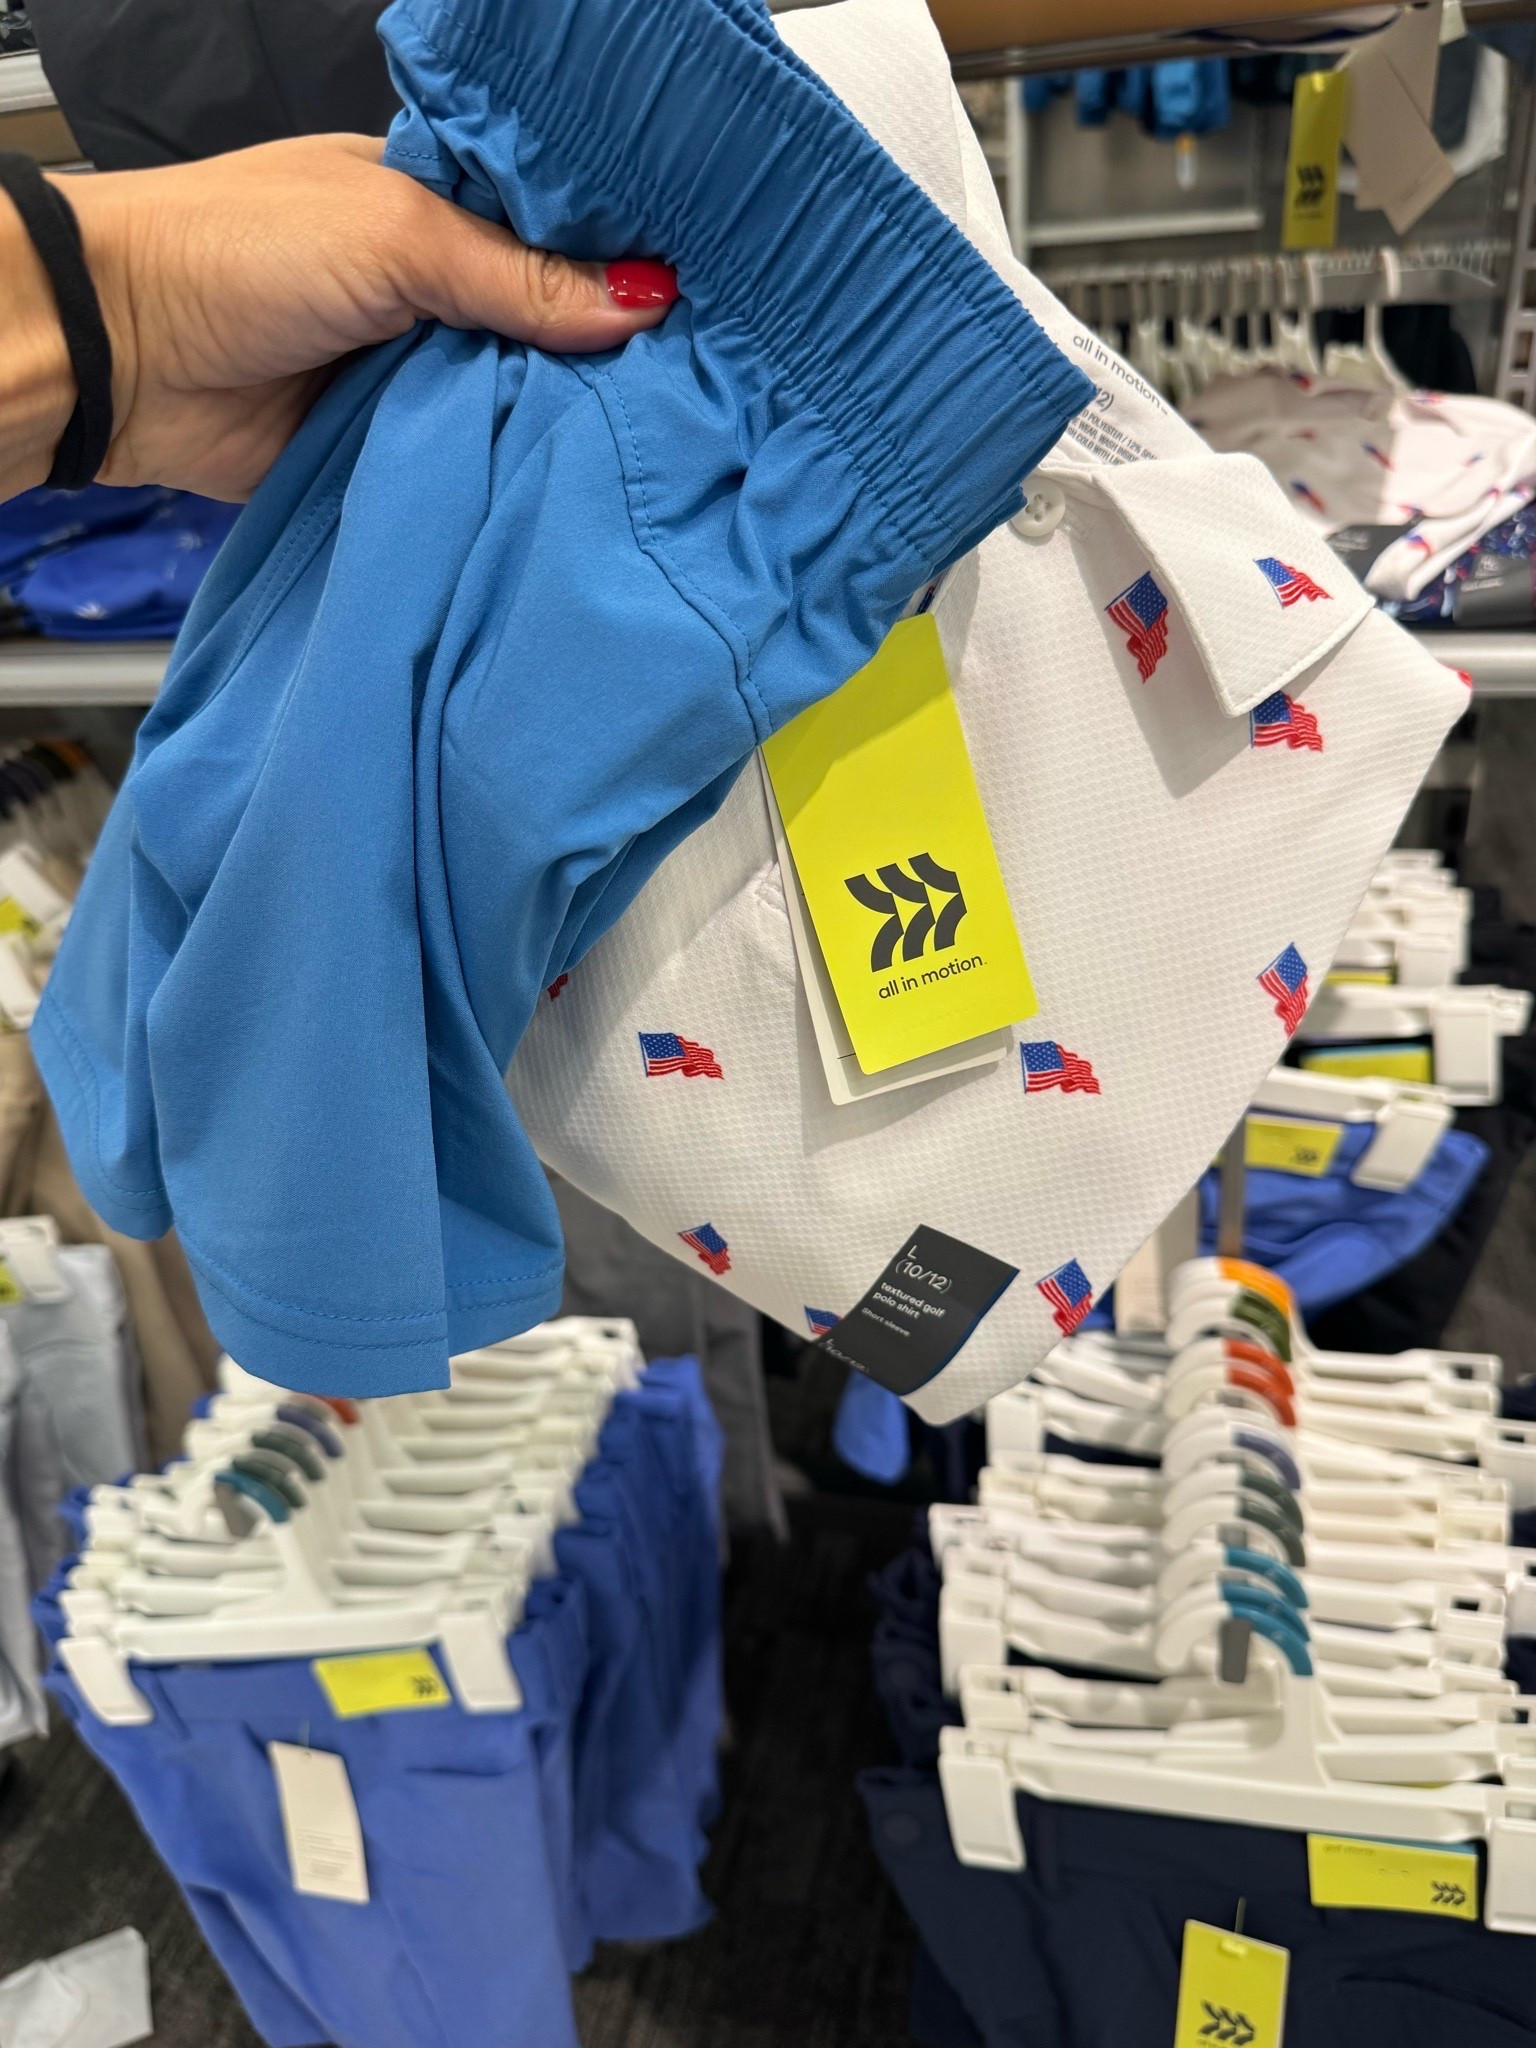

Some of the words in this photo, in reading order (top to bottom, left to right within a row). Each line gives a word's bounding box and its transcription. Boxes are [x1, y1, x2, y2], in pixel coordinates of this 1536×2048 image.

[1073, 335, 1093, 353] all
[1094, 345, 1109, 366] in
[1111, 360, 1161, 408] motion
[1076, 430, 1095, 450] COLD
[1088, 412, 1123, 441] POLYESTER
[1098, 433, 1119, 452] WASH
[878, 979, 899, 999] all
[900, 976, 919, 992] in
[921, 955, 983, 985] motion
[907, 1244, 918, 1260] L
[895, 1258, 953, 1294] (10/12)
[872, 1291, 897, 1306] polo
[896, 1302, 921, 1320] shirt
[880, 1281, 925, 1308] textured
[922, 1303, 946, 1319] golf
